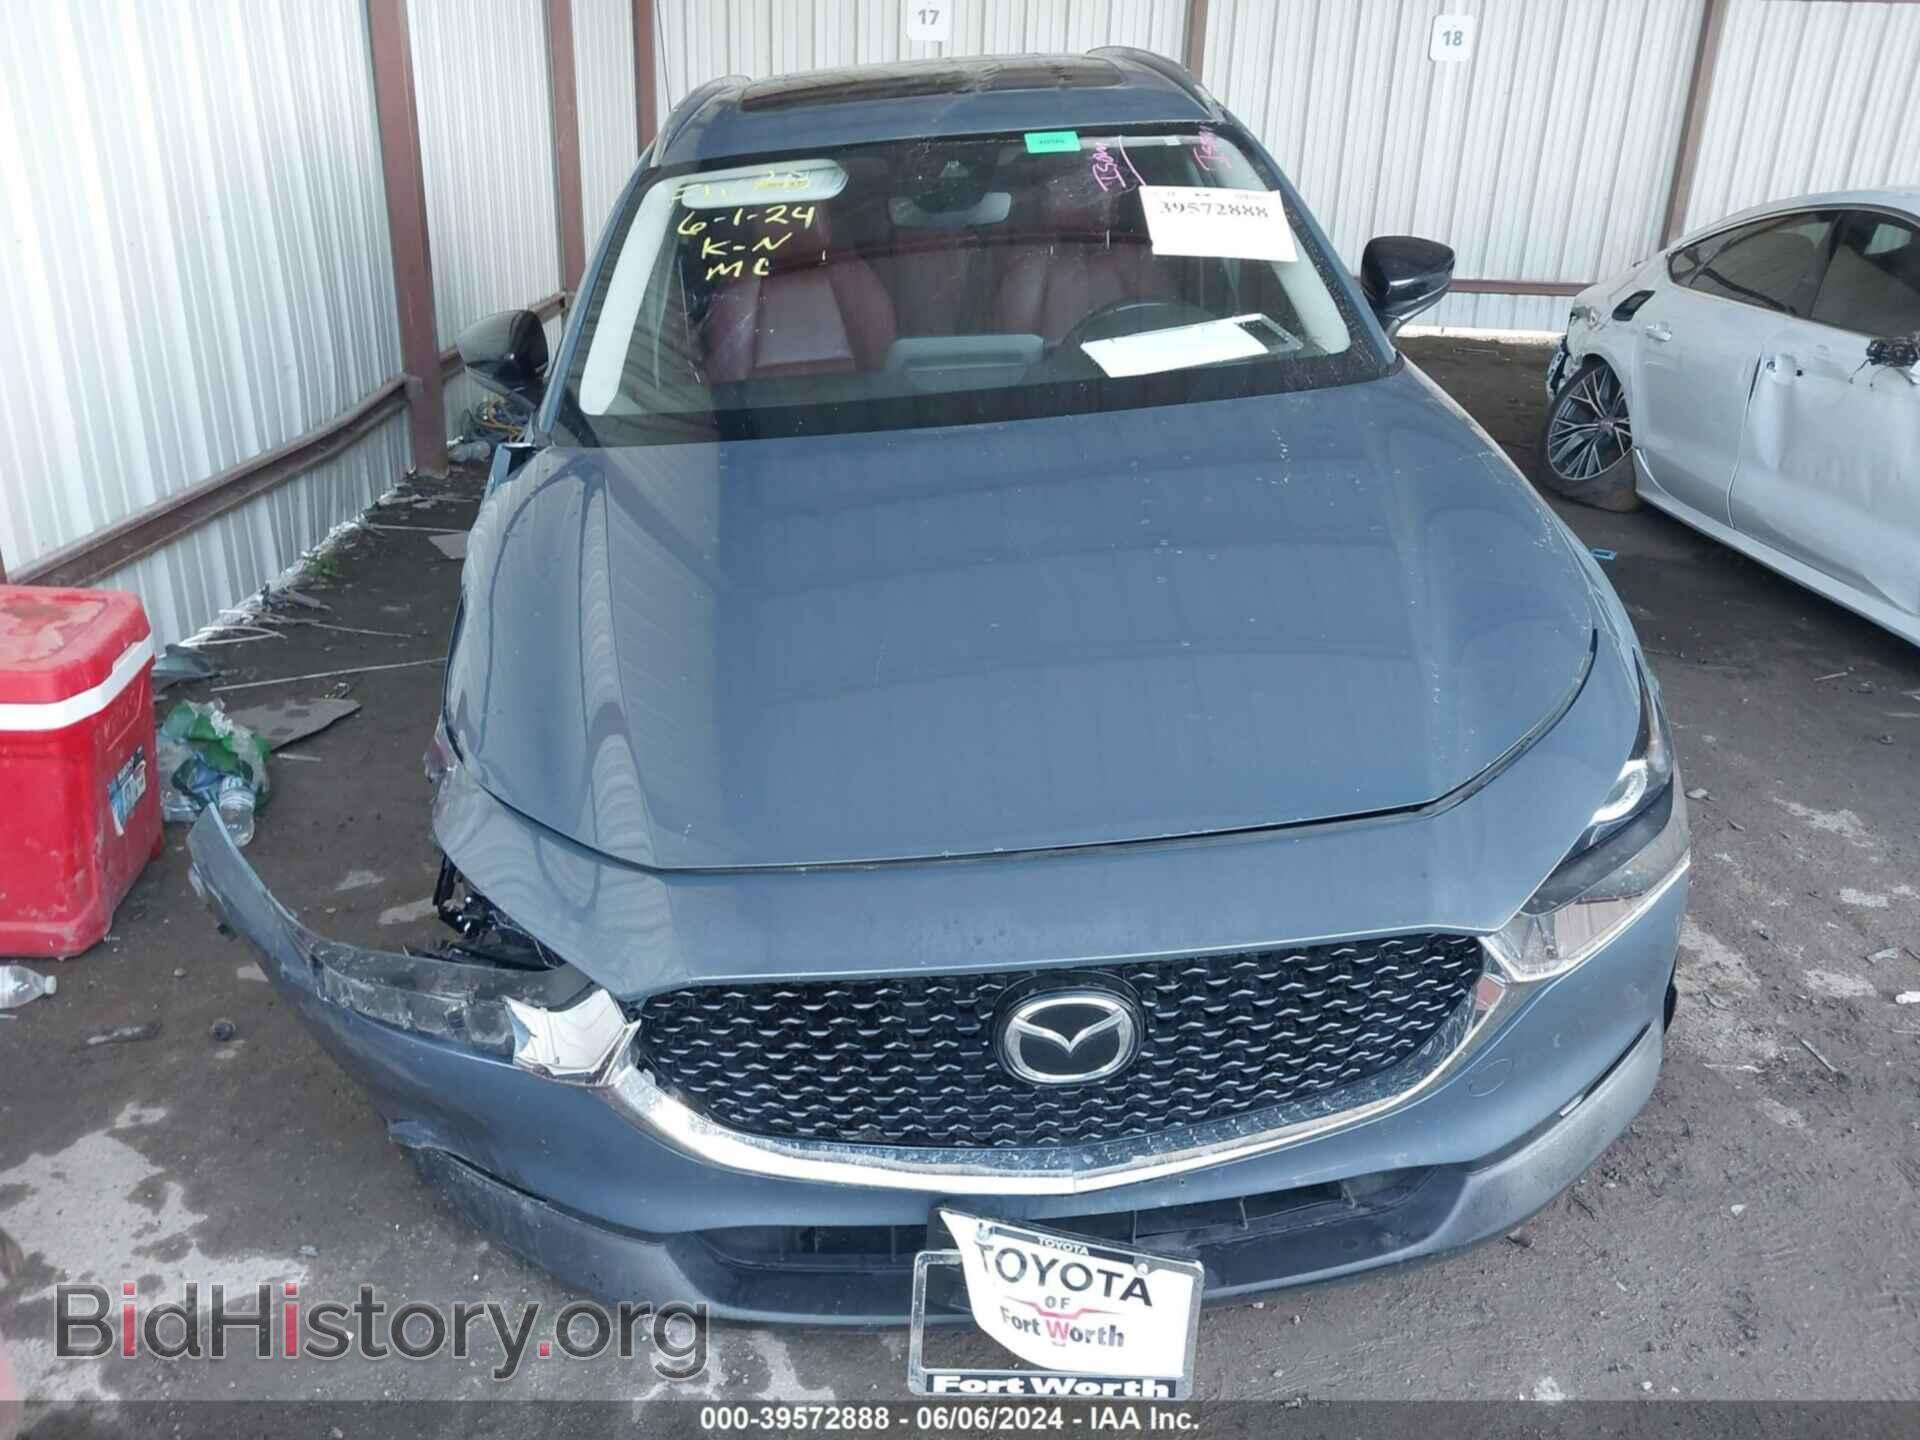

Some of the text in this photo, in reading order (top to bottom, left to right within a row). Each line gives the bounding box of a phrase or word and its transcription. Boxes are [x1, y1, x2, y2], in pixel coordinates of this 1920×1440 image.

[918, 9, 940, 25] 17
[1443, 30, 1463, 46] 18
[1160, 200, 1270, 218] 39572888
[677, 204, 815, 236] 6-1-24
[1037, 1236, 1090, 1256] TOYOTA
[974, 1241, 1153, 1307] TOYOTA
[1045, 1296, 1071, 1310] OF
[1000, 1306, 1125, 1348] Fort Worth
[932, 1375, 1170, 1398] Fort Worth
